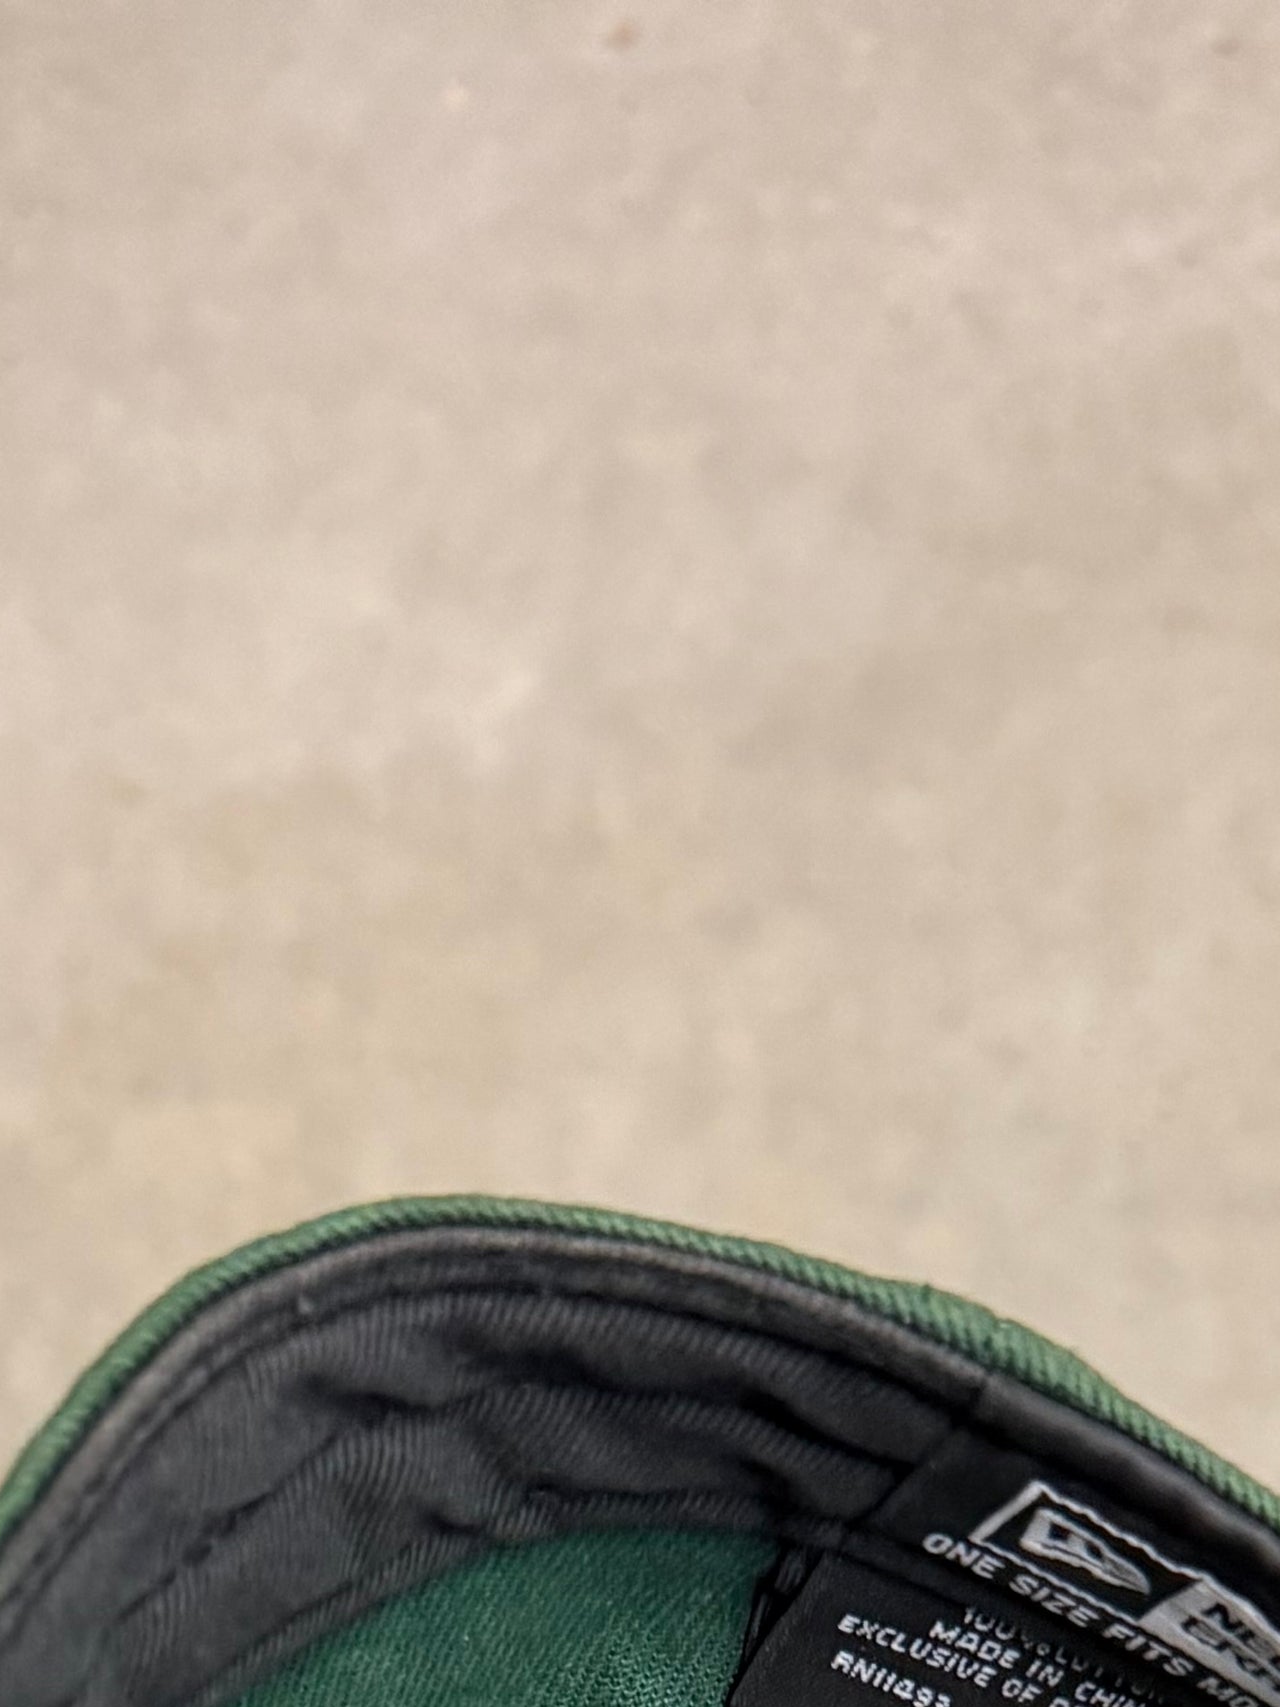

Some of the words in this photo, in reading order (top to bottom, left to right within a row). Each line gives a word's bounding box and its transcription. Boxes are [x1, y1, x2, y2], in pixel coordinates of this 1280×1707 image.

[923, 1533, 1006, 1580] ONE
[1009, 1574, 1100, 1628] SIZE
[1102, 1623, 1194, 1677] FITS
[836, 1612, 998, 1689] EXCLUSIVE
[1001, 1678, 1043, 1703] OF
[928, 1620, 1022, 1670] MADE
[1025, 1659, 1065, 1687] IN
